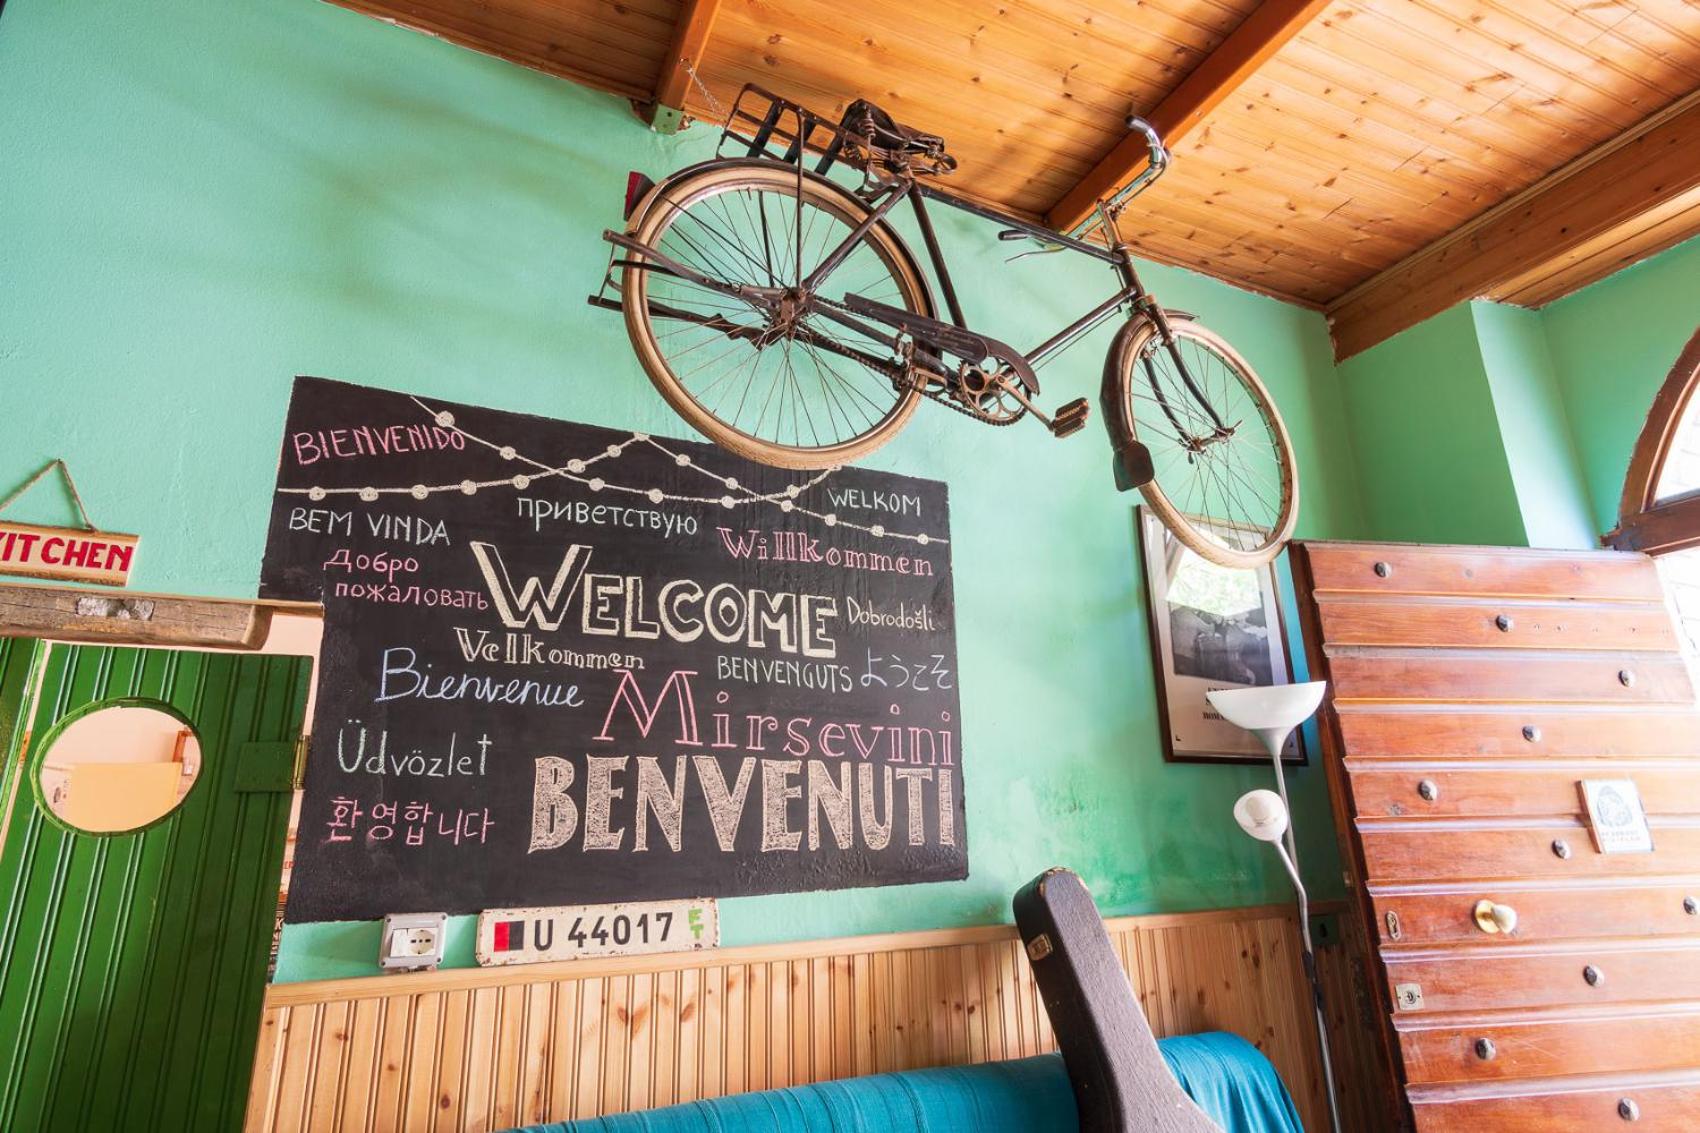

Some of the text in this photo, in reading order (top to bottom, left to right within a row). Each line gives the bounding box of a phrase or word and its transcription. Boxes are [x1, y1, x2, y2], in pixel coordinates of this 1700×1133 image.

[293, 424, 466, 465] BIENVENIDO
[517, 497, 698, 539] приветствую
[829, 489, 921, 516] WELKOM
[289, 507, 451, 546] BEM VINDA
[323, 549, 420, 582] Добро
[716, 526, 934, 577] Willkommen
[335, 582, 489, 611] пожаловать
[469, 540, 839, 659] WELCOME
[846, 595, 936, 632] Dobrodošli
[453, 626, 645, 670] Velkommen
[861, 647, 954, 692] ようこそ
[375, 647, 585, 707] Bienvenue
[717, 655, 852, 693] BENVENGUTS
[592, 669, 955, 766] Mirsevini
[337, 719, 493, 777] Üdvözlet
[326, 796, 495, 846] 환영합니다
[527, 753, 955, 854] BENVENUTI
[534, 911, 673, 951] U 44017
